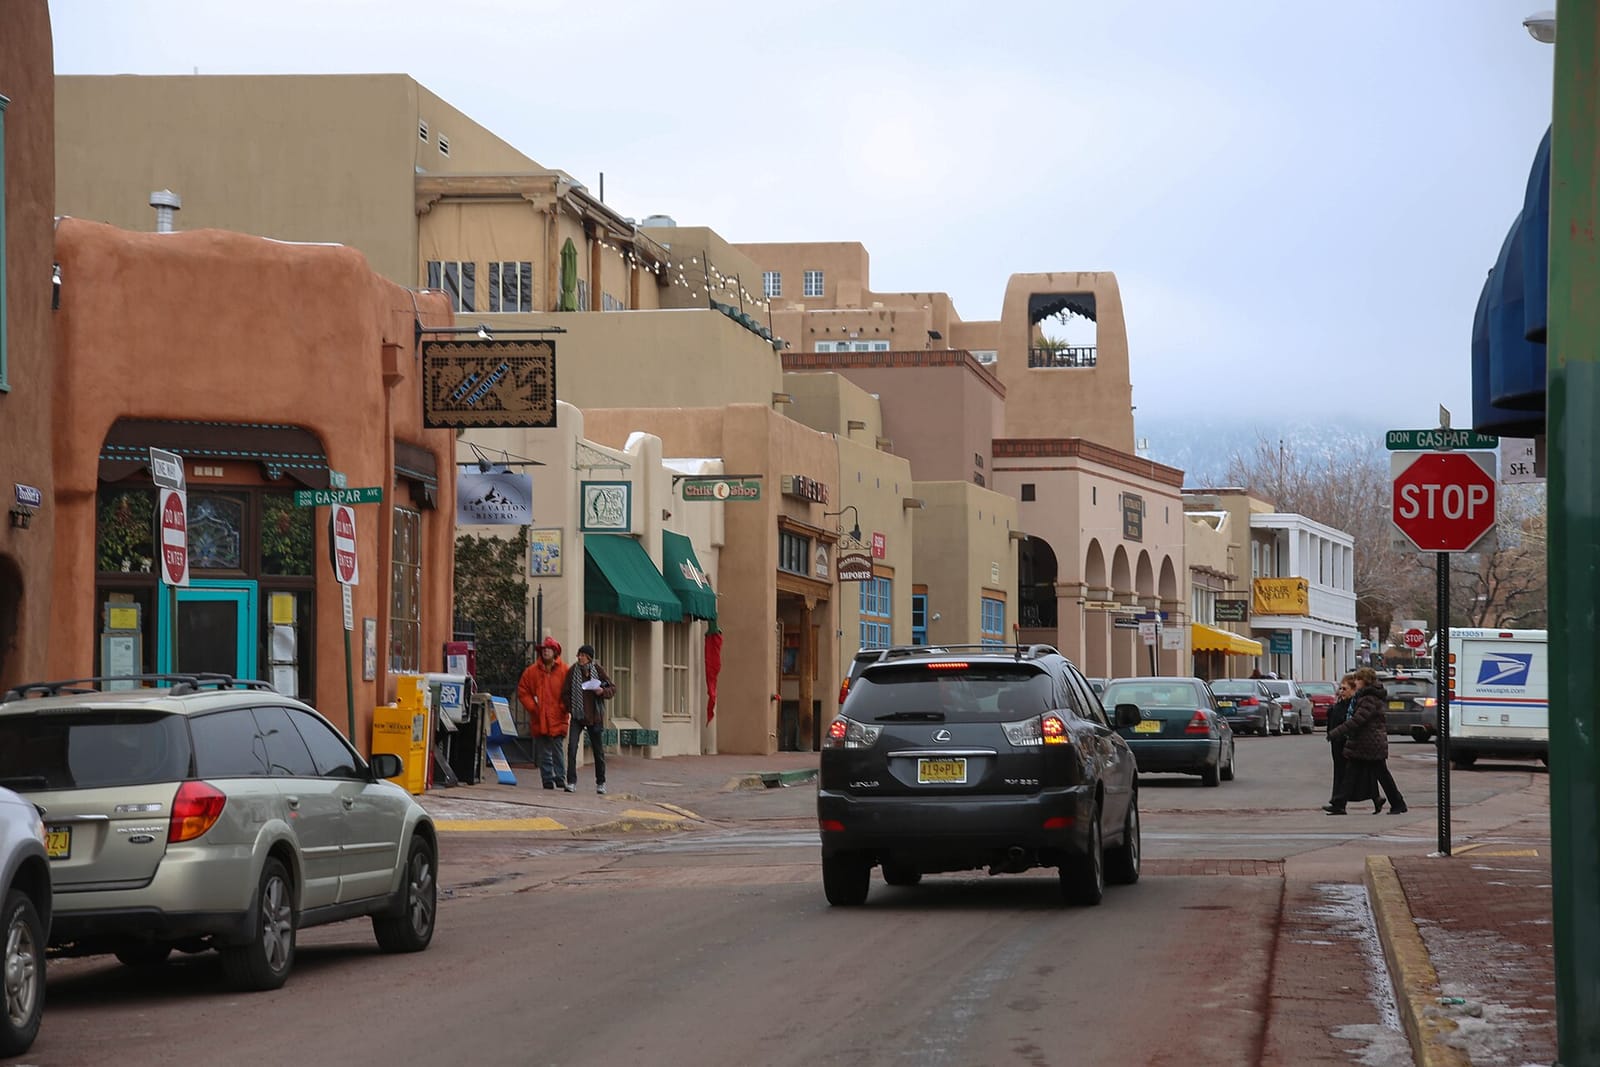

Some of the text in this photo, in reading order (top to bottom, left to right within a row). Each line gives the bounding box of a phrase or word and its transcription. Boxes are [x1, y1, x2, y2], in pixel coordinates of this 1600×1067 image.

[1389, 431, 1495, 447] DON GASPAR AVE
[315, 490, 361, 504] GASPAR
[367, 489, 378, 497] AVE
[730, 486, 757, 497] Shop
[1399, 483, 1489, 520] STOP
[165, 508, 184, 526] DO NOT
[343, 522, 352, 535] NOT
[166, 550, 184, 567] ENTER
[338, 554, 354, 569] ENTER
[840, 570, 871, 580] IMPORTS
[1405, 635, 1424, 644] STOP
[1476, 687, 1526, 695] www.usps.com
